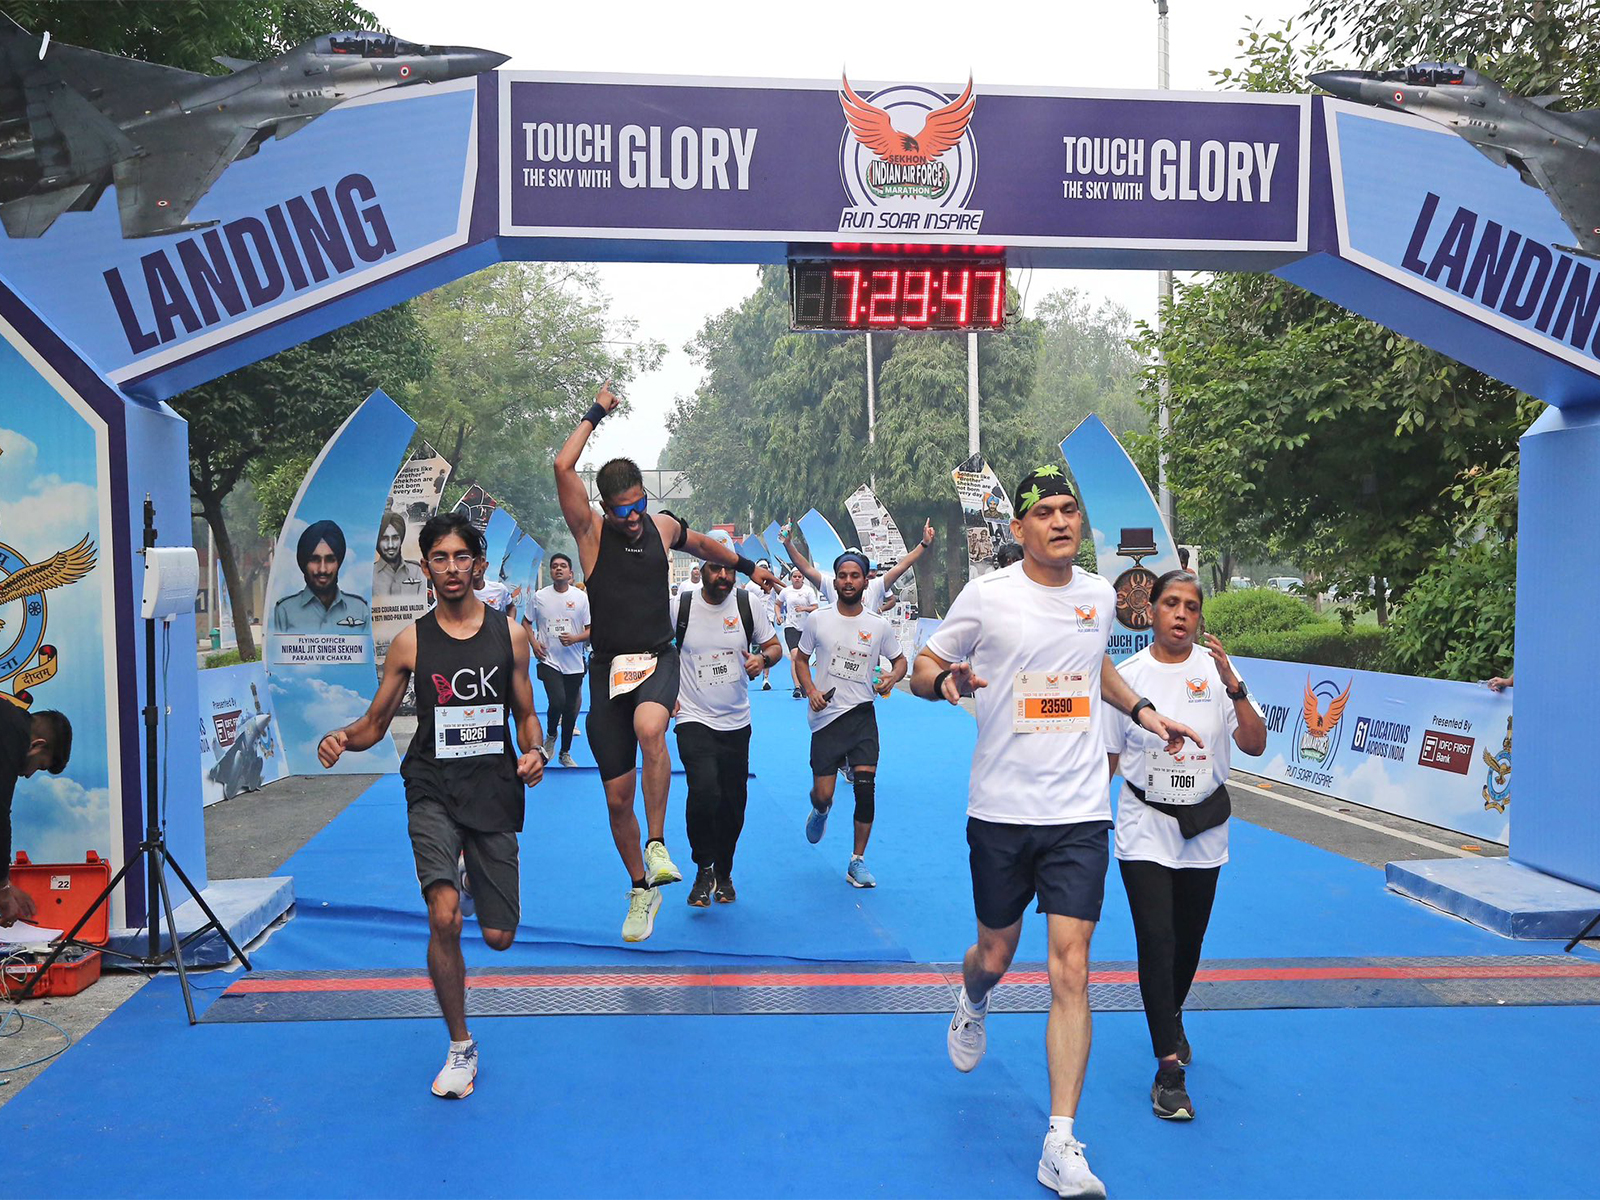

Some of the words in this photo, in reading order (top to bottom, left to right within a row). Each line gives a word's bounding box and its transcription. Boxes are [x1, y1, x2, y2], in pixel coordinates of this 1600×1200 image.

[522, 122, 612, 163] TOUCH
[619, 124, 758, 190] GLORY
[889, 155, 926, 163] SEKHON
[1063, 136, 1144, 176] TOUCH
[522, 167, 545, 187] THE
[548, 168, 576, 188] SKY
[578, 169, 611, 188] WITH
[872, 160, 901, 187] INDIAN
[902, 165, 915, 184] AIR
[916, 162, 943, 188] FORCE
[1150, 139, 1279, 203] GLORY
[884, 186, 930, 194] MARATHON
[1062, 180, 1083, 199] THE
[1085, 180, 1110, 200] SKY
[1112, 181, 1143, 201] WITH
[841, 212, 874, 229] RUN
[877, 212, 921, 229] SOAR
[923, 213, 981, 231] INSPIRE
[103, 173, 397, 354] LANDING
[1401, 192, 1600, 360] LANDIN
[833, 271, 1001, 322] 7:29:47
[282, 646, 306, 654] NIRMAL
[338, 645, 362, 653] SEKHON
[451, 666, 499, 700] GK
[1041, 698, 1072, 714] 23590
[460, 727, 486, 742] 50261
[1370, 719, 1411, 744] LOCATIONS
[1432, 715, 1464, 730] Presented
[1464, 722, 1473, 733] By
[1354, 721, 1369, 749] 61
[1366, 740, 1390, 759] ACROSS
[1388, 744, 1406, 762] INDIA
[1436, 752, 1451, 764] Bank
[1438, 740, 1454, 750] IDFC
[1454, 742, 1472, 756] FIRST
[1170, 775, 1194, 788] 17061
